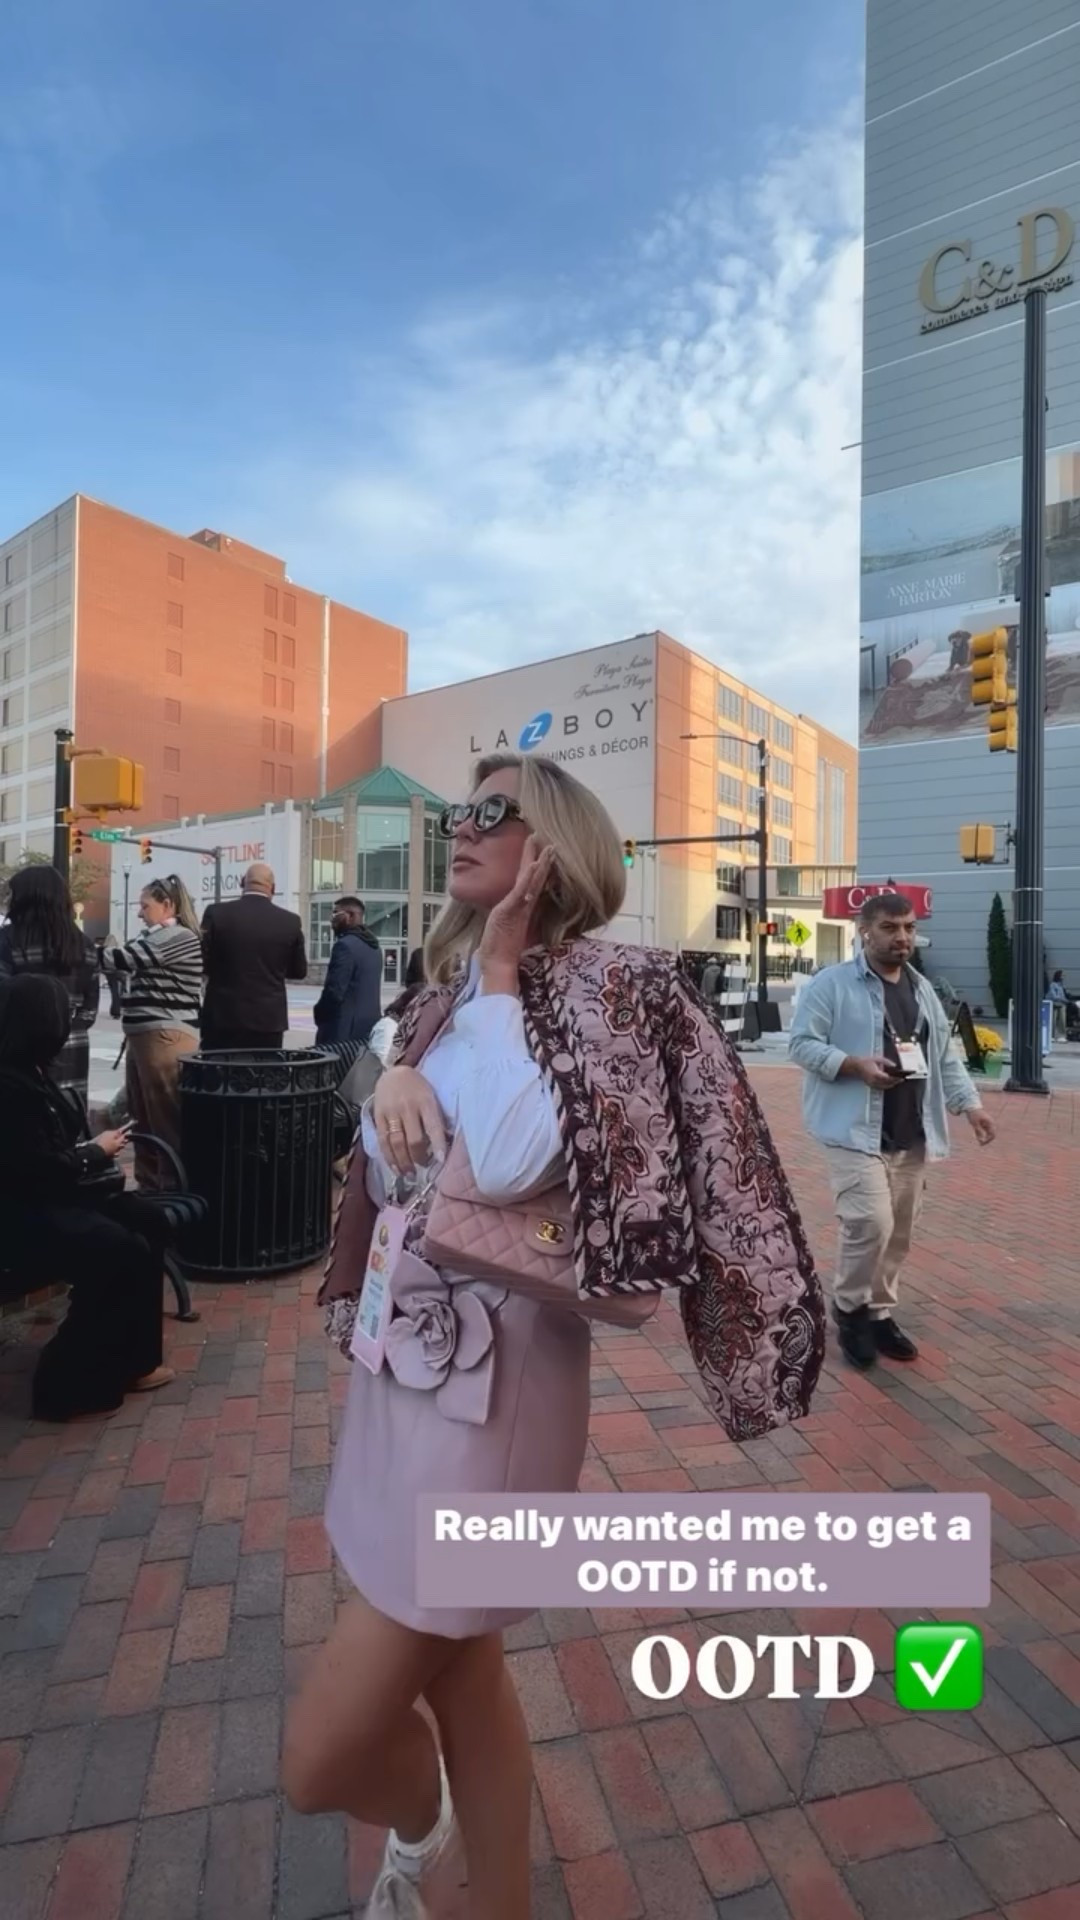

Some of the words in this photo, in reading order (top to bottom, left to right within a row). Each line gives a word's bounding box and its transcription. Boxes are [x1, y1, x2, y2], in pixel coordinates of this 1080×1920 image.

[918, 207, 1076, 314] C&D
[925, 571, 966, 590] MARIE
[588, 744, 597, 758] &
[601, 735, 649, 755] DÉCOR
